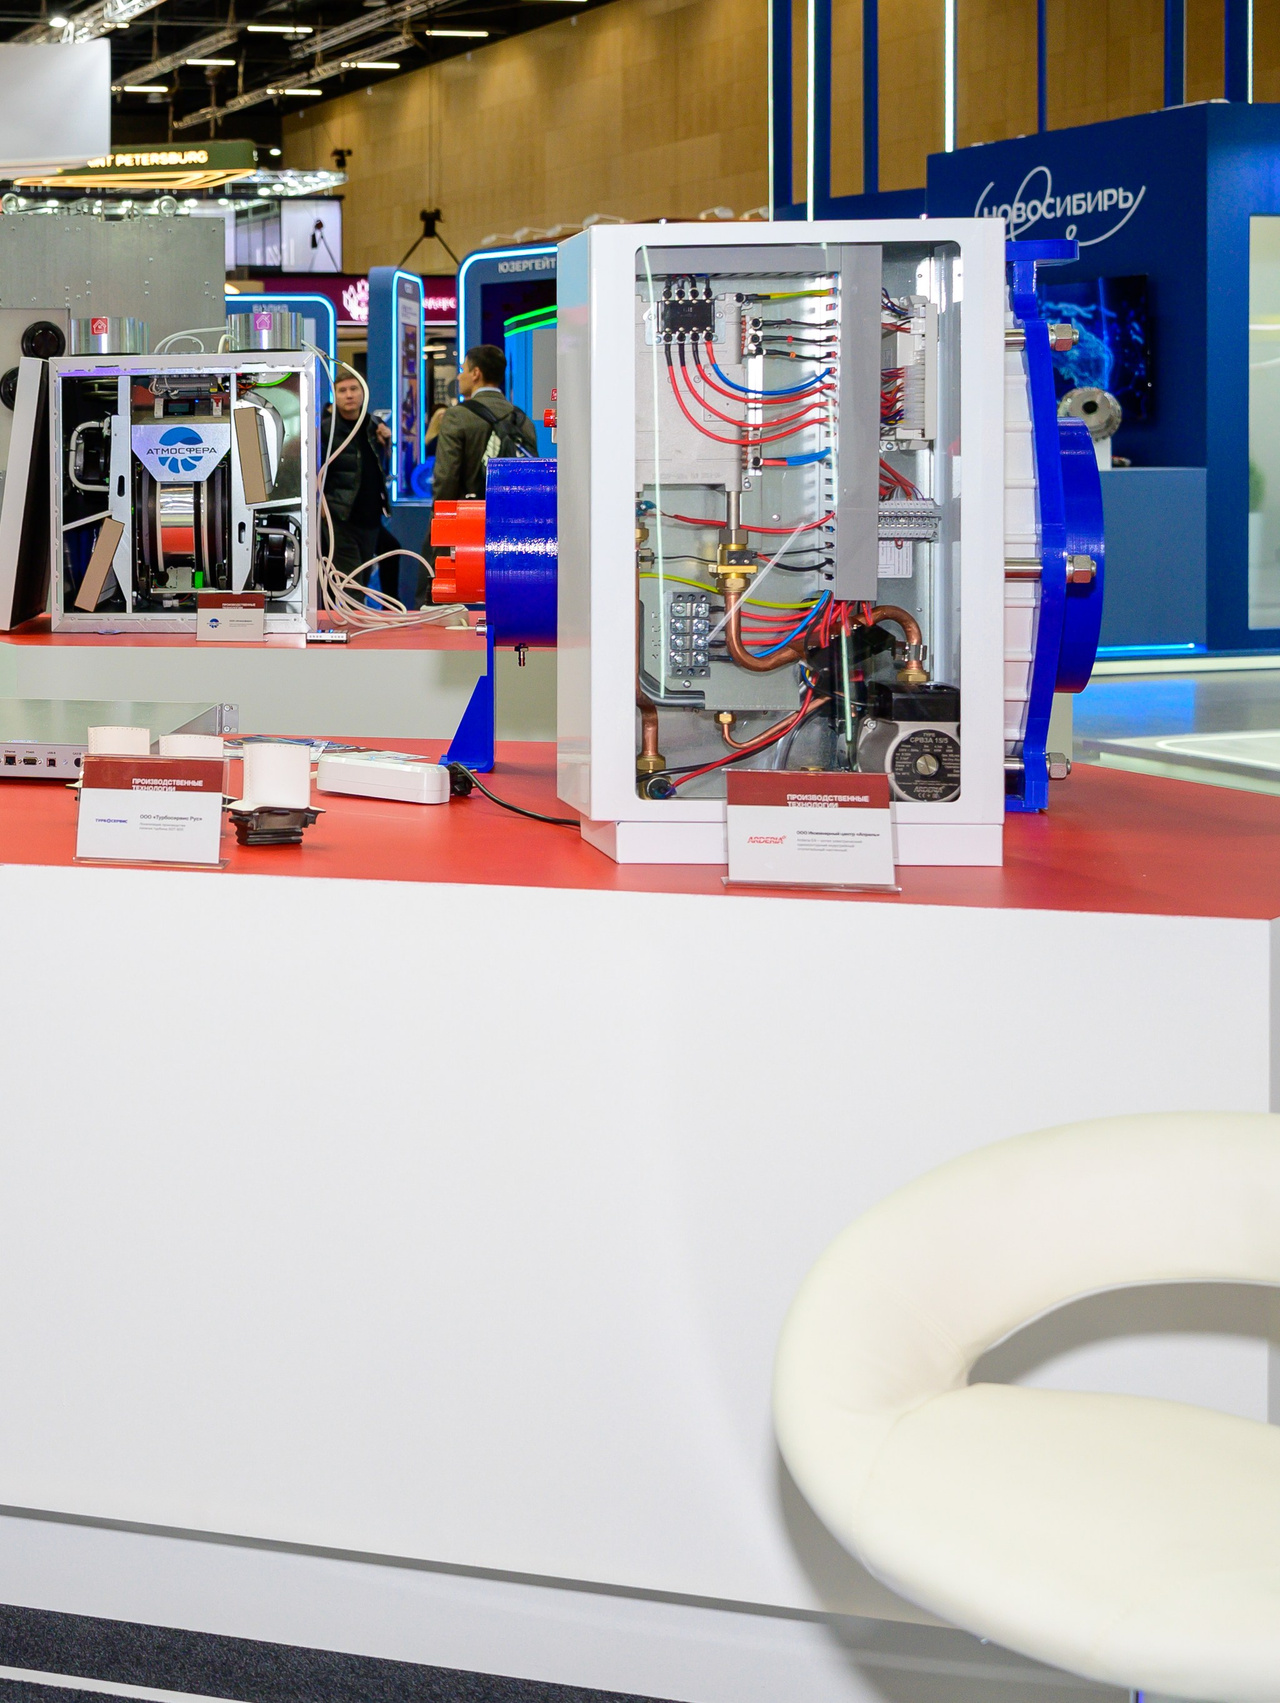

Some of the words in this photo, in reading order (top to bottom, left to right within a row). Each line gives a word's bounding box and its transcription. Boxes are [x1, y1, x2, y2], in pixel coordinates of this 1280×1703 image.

[115, 150, 208, 167] PETERSBURG
[146, 447, 217, 455] АТМОСФЕРА
[132, 778, 204, 787] ПРОИЗВОДСТВЕННЫЕ
[786, 793, 870, 803] ПРОИЗВОДСТВЕННЫЕ
